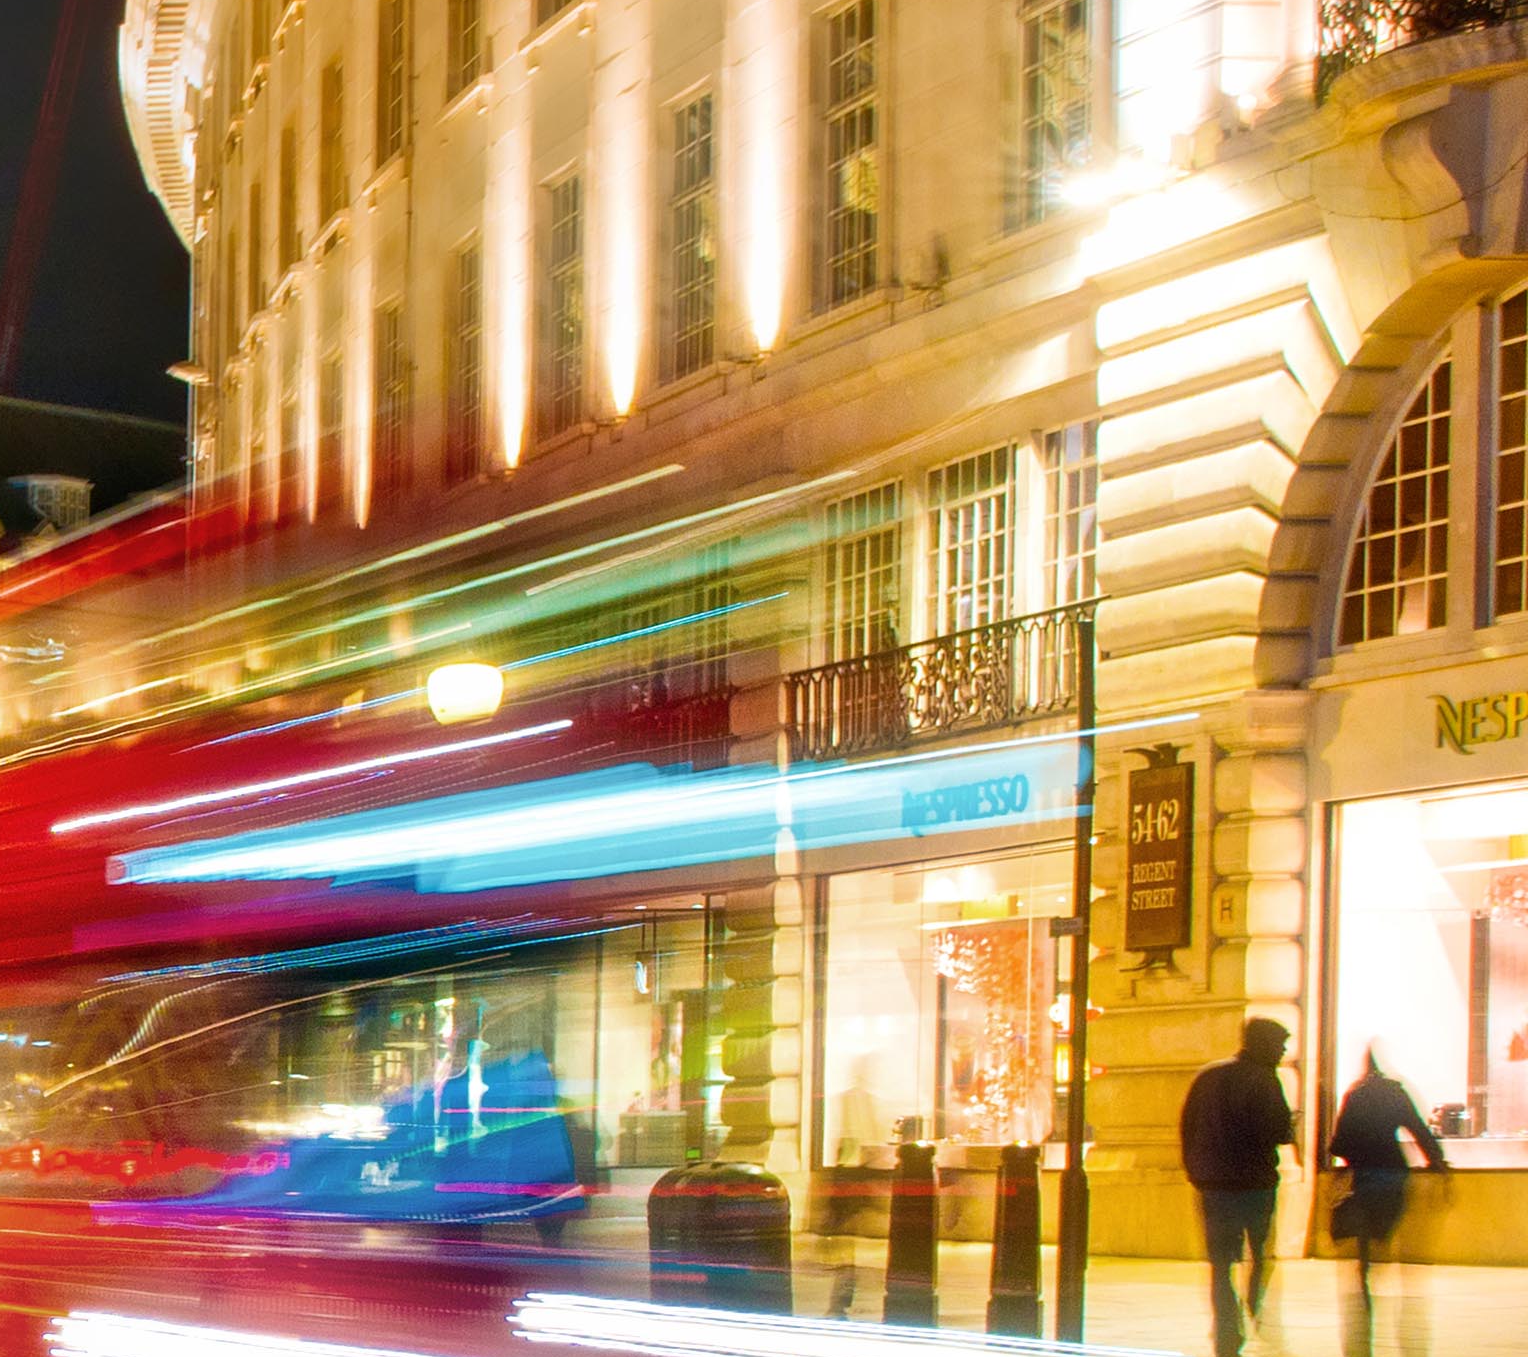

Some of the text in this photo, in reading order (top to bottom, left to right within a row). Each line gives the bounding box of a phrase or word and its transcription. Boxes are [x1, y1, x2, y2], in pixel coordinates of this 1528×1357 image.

[1132, 798, 1179, 844] 54-62
[1132, 860, 1176, 884] REGENT
[1131, 887, 1176, 910] STREET
